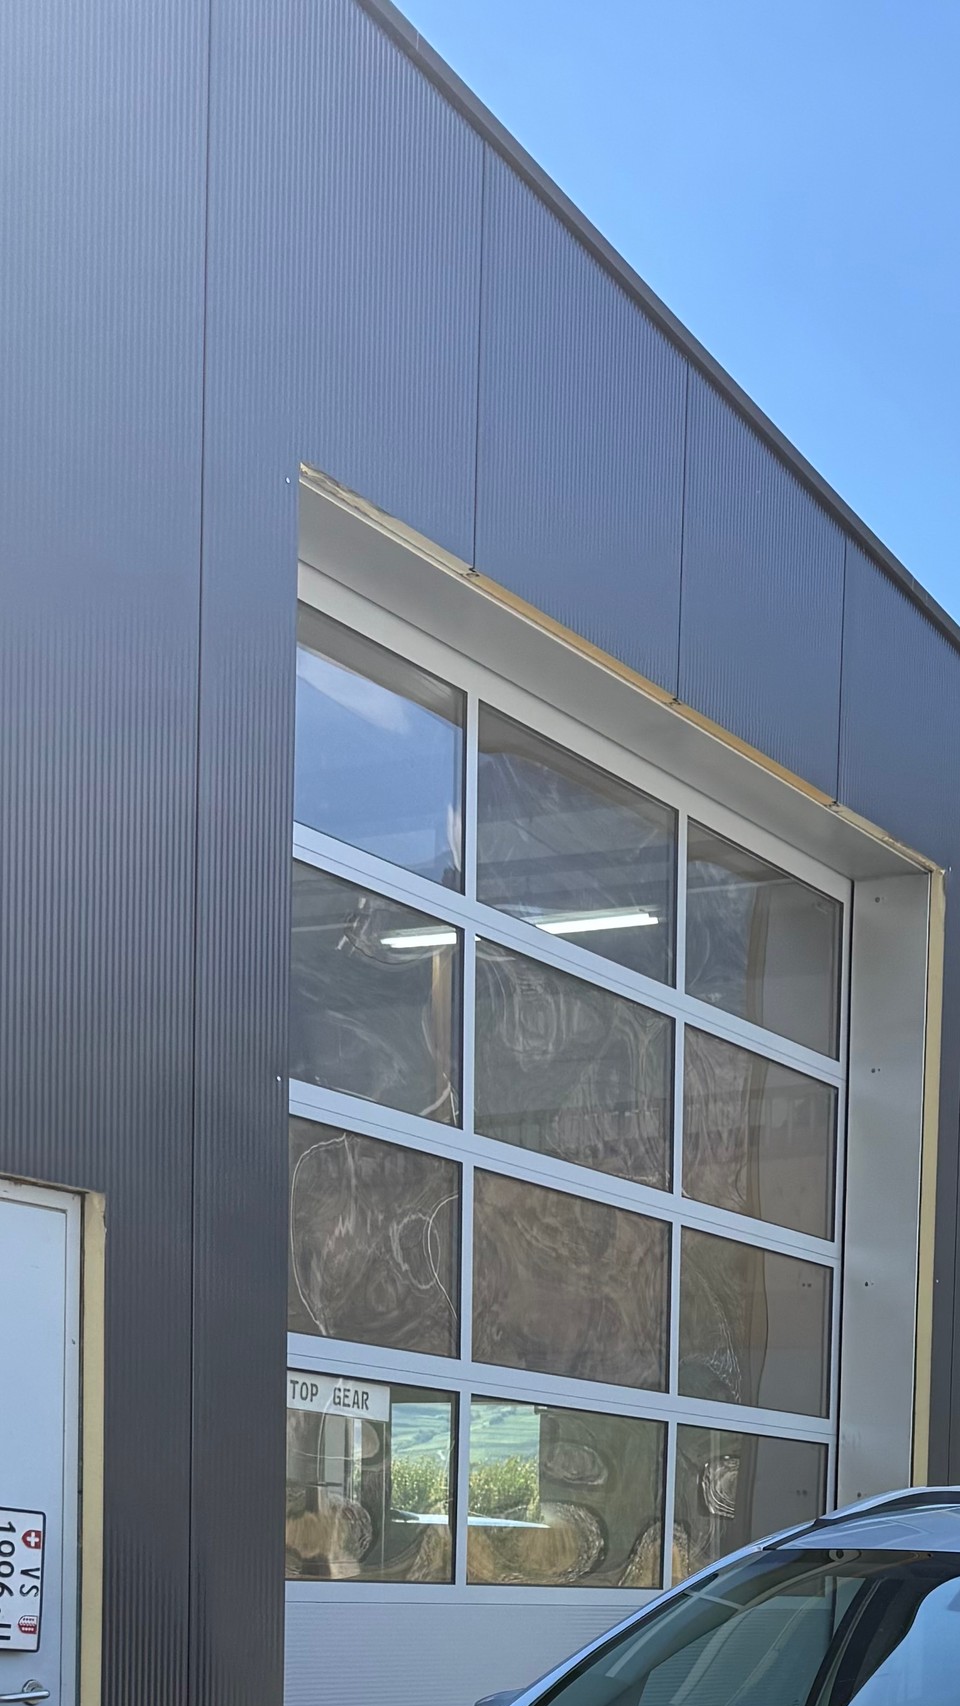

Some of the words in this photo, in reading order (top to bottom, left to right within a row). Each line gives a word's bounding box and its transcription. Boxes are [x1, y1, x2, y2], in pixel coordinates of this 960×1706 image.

[289, 1379, 319, 1402] TOP
[332, 1386, 370, 1411] GEAR
[19, 1567, 41, 1598] VS
